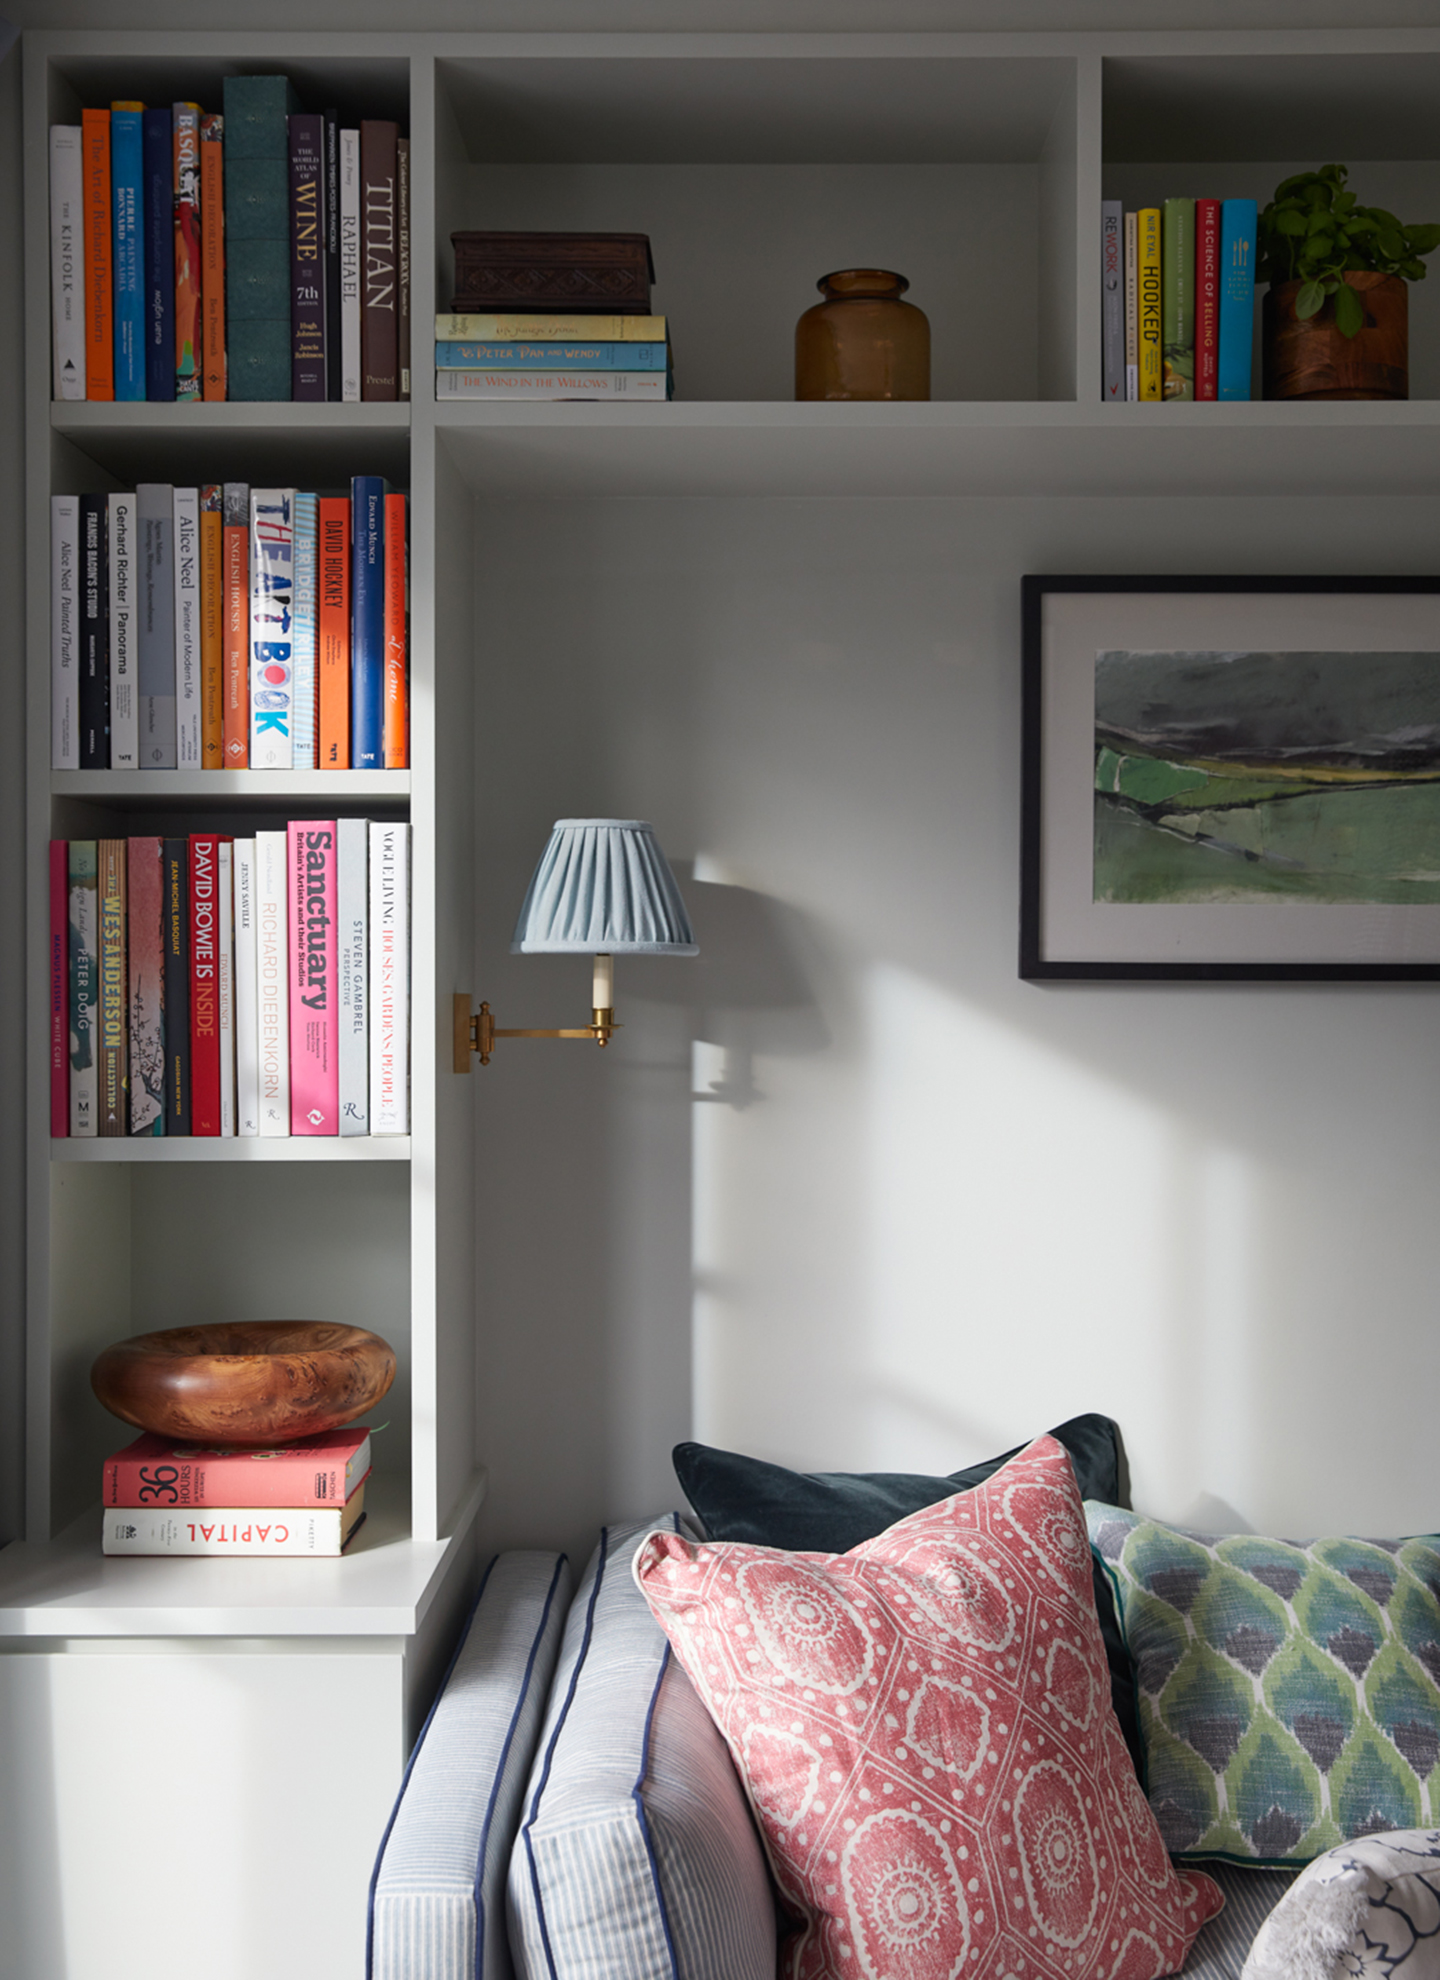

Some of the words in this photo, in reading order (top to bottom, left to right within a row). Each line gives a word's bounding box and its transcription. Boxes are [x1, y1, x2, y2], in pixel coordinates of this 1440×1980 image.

[92, 136, 104, 162] The
[92, 166, 105, 187] Art
[92, 191, 106, 204] of
[117, 187, 126, 240] BONNARD
[127, 187, 135, 232] PIERRE
[1206, 206, 1215, 225] THE
[92, 210, 106, 262] Richard
[208, 204, 217, 270] DECORATION
[296, 180, 318, 262] WINE
[1147, 216, 1155, 232] NIR
[61, 225, 72, 292] KINFOLK
[342, 215, 357, 303] RAPHAEL
[366, 177, 394, 312] TITIAN
[400, 230, 410, 285] DELACROIX
[1105, 216, 1117, 273] REWORK
[1147, 235, 1156, 258] EYAL
[1204, 230, 1214, 278] SCIENCE
[118, 244, 127, 292] ARCADIA
[128, 238, 136, 292] PAINTING
[94, 266, 108, 344] Diebenkorn
[153, 290, 164, 319] uglow
[209, 298, 218, 314] Ben
[297, 286, 319, 300] 7th
[1144, 266, 1159, 340] HOOKED
[1204, 282, 1214, 298] OF
[474, 345, 514, 360] PETER
[516, 345, 544, 360] PAN
[564, 350, 600, 359] WENDY
[366, 375, 394, 385] Prestel
[462, 376, 483, 387] THE
[486, 376, 518, 388] WIND
[520, 377, 532, 388] IN
[534, 377, 555, 388] THE
[557, 377, 608, 388] WILLOWS
[86, 512, 98, 548] FRANCIS
[116, 506, 128, 556] Gerhard
[255, 494, 292, 563] THE
[368, 495, 377, 530] EDVARD
[61, 541, 72, 566] Alice
[180, 516, 194, 553] Alice
[206, 526, 216, 572] ENGLISH
[324, 520, 343, 553] DAVID
[368, 531, 378, 564] MUNCH
[390, 510, 400, 561] WILLIAM
[86, 550, 98, 586] BACON'S
[180, 557, 195, 590] Neel
[230, 534, 240, 584] ENGLISH
[61, 568, 72, 591] Neel
[117, 559, 129, 602] Richter
[298, 539, 310, 625] BRIDGET
[325, 558, 343, 609] HOCKNEY
[391, 564, 400, 626] YEOWARD
[61, 596, 72, 634] Painted
[87, 588, 98, 618] STUDIO
[182, 601, 192, 631] Painter
[207, 574, 216, 638] DECORATION
[230, 586, 240, 632] HOUSES
[254, 572, 292, 634] ART
[61, 635, 72, 668] Truths
[118, 612, 129, 674] Panorama
[184, 632, 193, 642] of
[184, 644, 193, 680] Modern
[208, 666, 216, 683] Ben
[231, 651, 240, 668] Ben
[298, 634, 310, 688] RILEY
[184, 682, 194, 699] Life
[230, 670, 240, 709] Pentreath
[254, 642, 292, 738] BOOK
[388, 659, 404, 704] home
[330, 742, 338, 762] TATE
[195, 842, 212, 899] DAVID
[296, 832, 304, 871] Britain's
[382, 831, 394, 875] VOGUE
[170, 860, 180, 914] JEAN-MICHEL
[241, 862, 249, 892] JENNY
[297, 873, 305, 906] Artists
[102, 896, 121, 941] WES
[242, 893, 250, 928] SAVILLE
[297, 908, 305, 924] and
[302, 831, 332, 1010] Sanctuary
[382, 878, 394, 924] LIVING
[172, 915, 180, 955] BASQUIAT
[196, 902, 213, 961] BOWIE
[262, 902, 277, 979] RICHARD
[298, 926, 306, 950] their
[352, 920, 362, 968] STEVEN
[78, 948, 88, 987] PETER
[196, 964, 214, 978] IS
[298, 952, 306, 988] Studios
[343, 948, 351, 1006] PERSPECTIVE
[77, 992, 88, 1030] DOIG
[102, 944, 121, 1048] ANDERSON
[196, 982, 214, 1037] INSIDE
[354, 975, 363, 1034] GAMBREL
[54, 1046, 62, 1068] CUBE
[263, 986, 278, 1098] DIEBENKORN
[106, 1052, 116, 1108] COLLECTION
[382, 1054, 394, 1108] PEOPLE
[139, 1465, 179, 1504] 36
[180, 1465, 191, 1504] HOURS
[186, 1524, 289, 1543] CAPITAL
